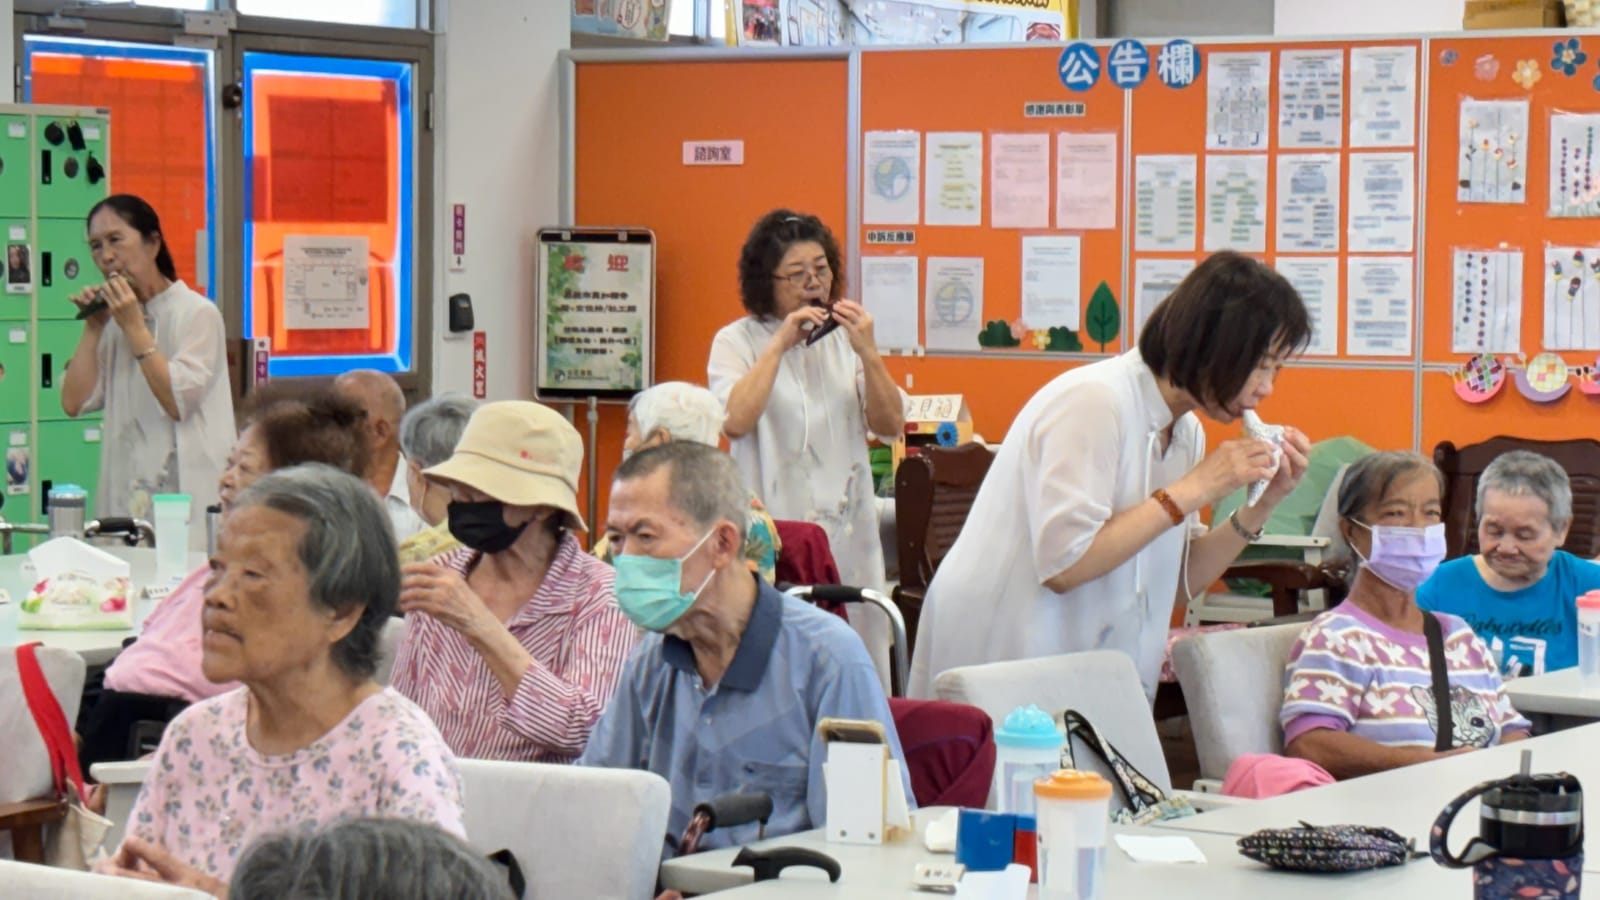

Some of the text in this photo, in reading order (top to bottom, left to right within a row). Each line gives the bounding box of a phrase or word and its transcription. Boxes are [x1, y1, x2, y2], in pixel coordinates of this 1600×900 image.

[1061, 42, 1194, 84] 公告欄
[694, 145, 732, 161] 諮詢室
